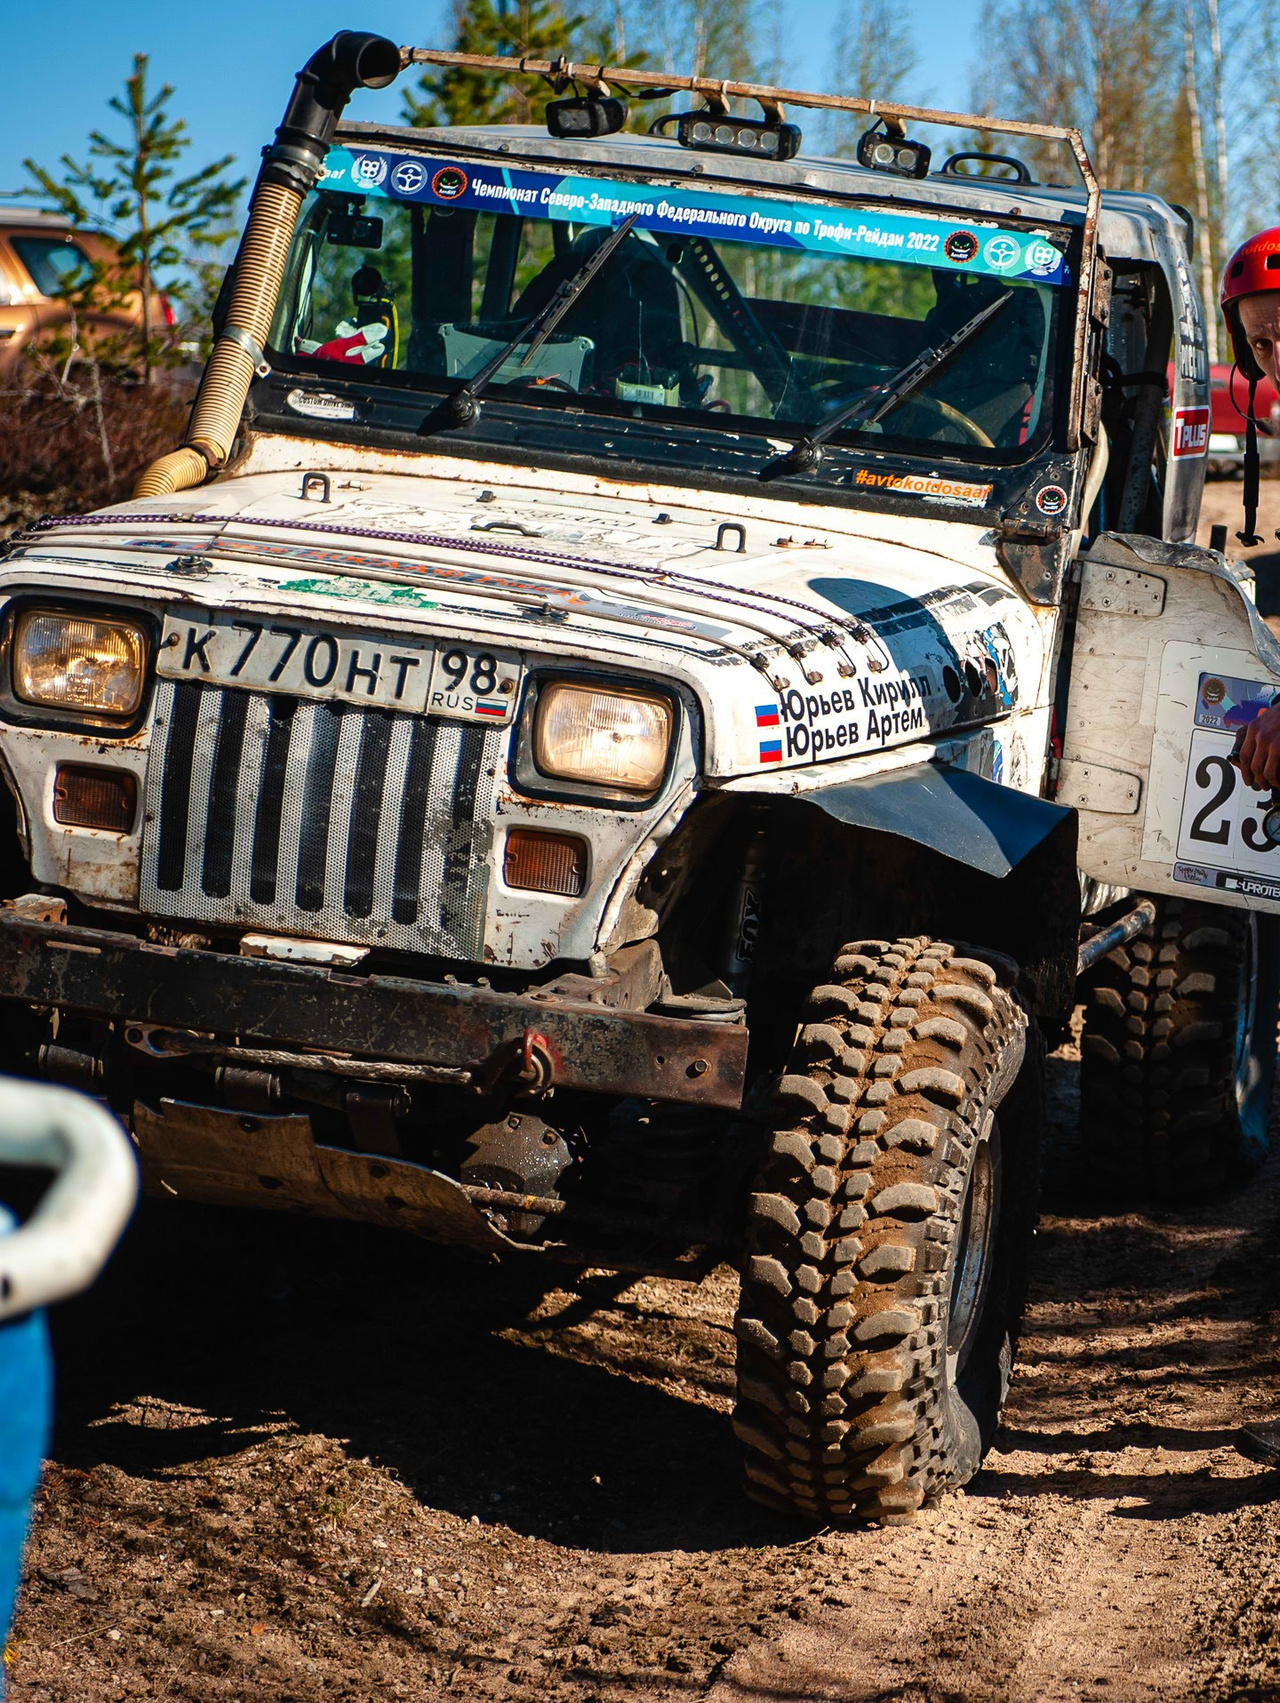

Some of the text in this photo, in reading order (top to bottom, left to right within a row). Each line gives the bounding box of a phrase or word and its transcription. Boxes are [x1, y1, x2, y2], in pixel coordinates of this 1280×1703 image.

[472, 178, 940, 252] Чемпионат Северо-Западного Федерального Округа по Трофи-Рейдам 2022
[1176, 418, 1207, 449] TPLUS
[855, 469, 993, 499] #avtokotdosaaf
[440, 648, 499, 697] 98
[431, 692, 474, 712] RUS
[780, 673, 932, 726] Юрьев Кирилл
[1201, 713, 1218, 726] 2022
[786, 707, 924, 761] Юрьев Артем
